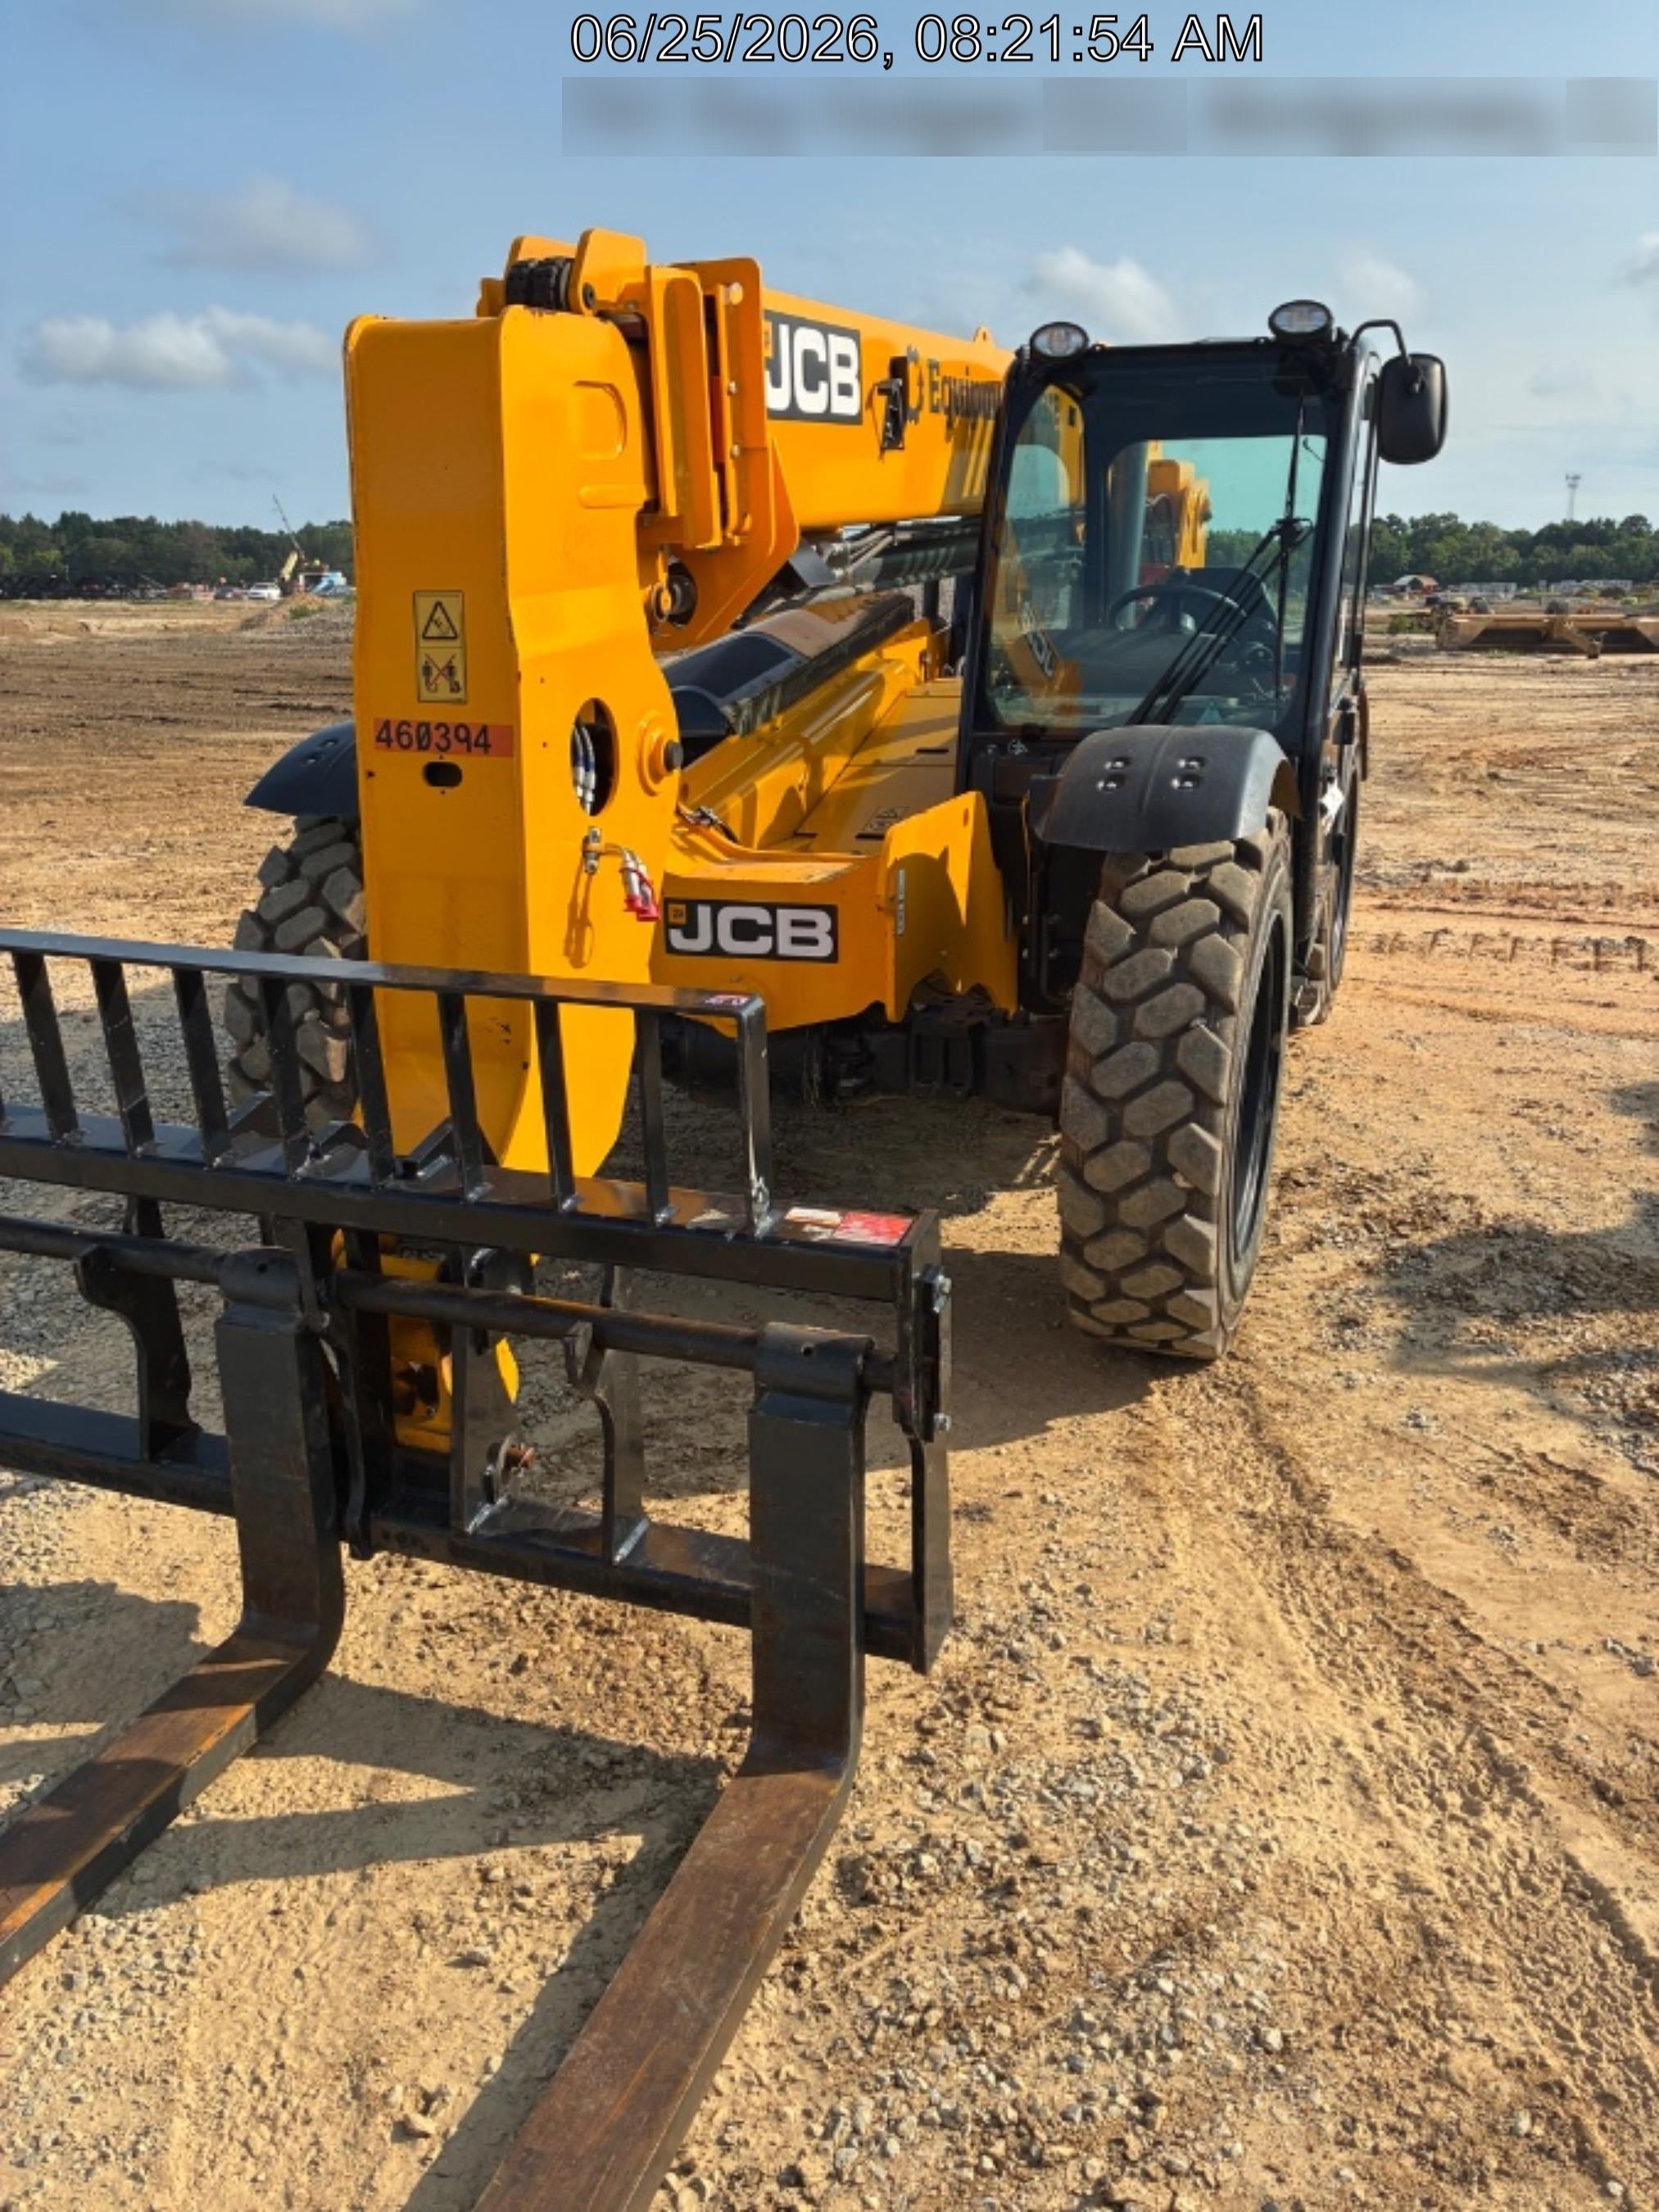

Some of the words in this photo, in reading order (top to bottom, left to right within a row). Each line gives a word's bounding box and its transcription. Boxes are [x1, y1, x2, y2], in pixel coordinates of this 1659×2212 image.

[764, 323, 860, 416] JCB
[375, 719, 492, 754] 460394
[669, 904, 834, 958] JCB
